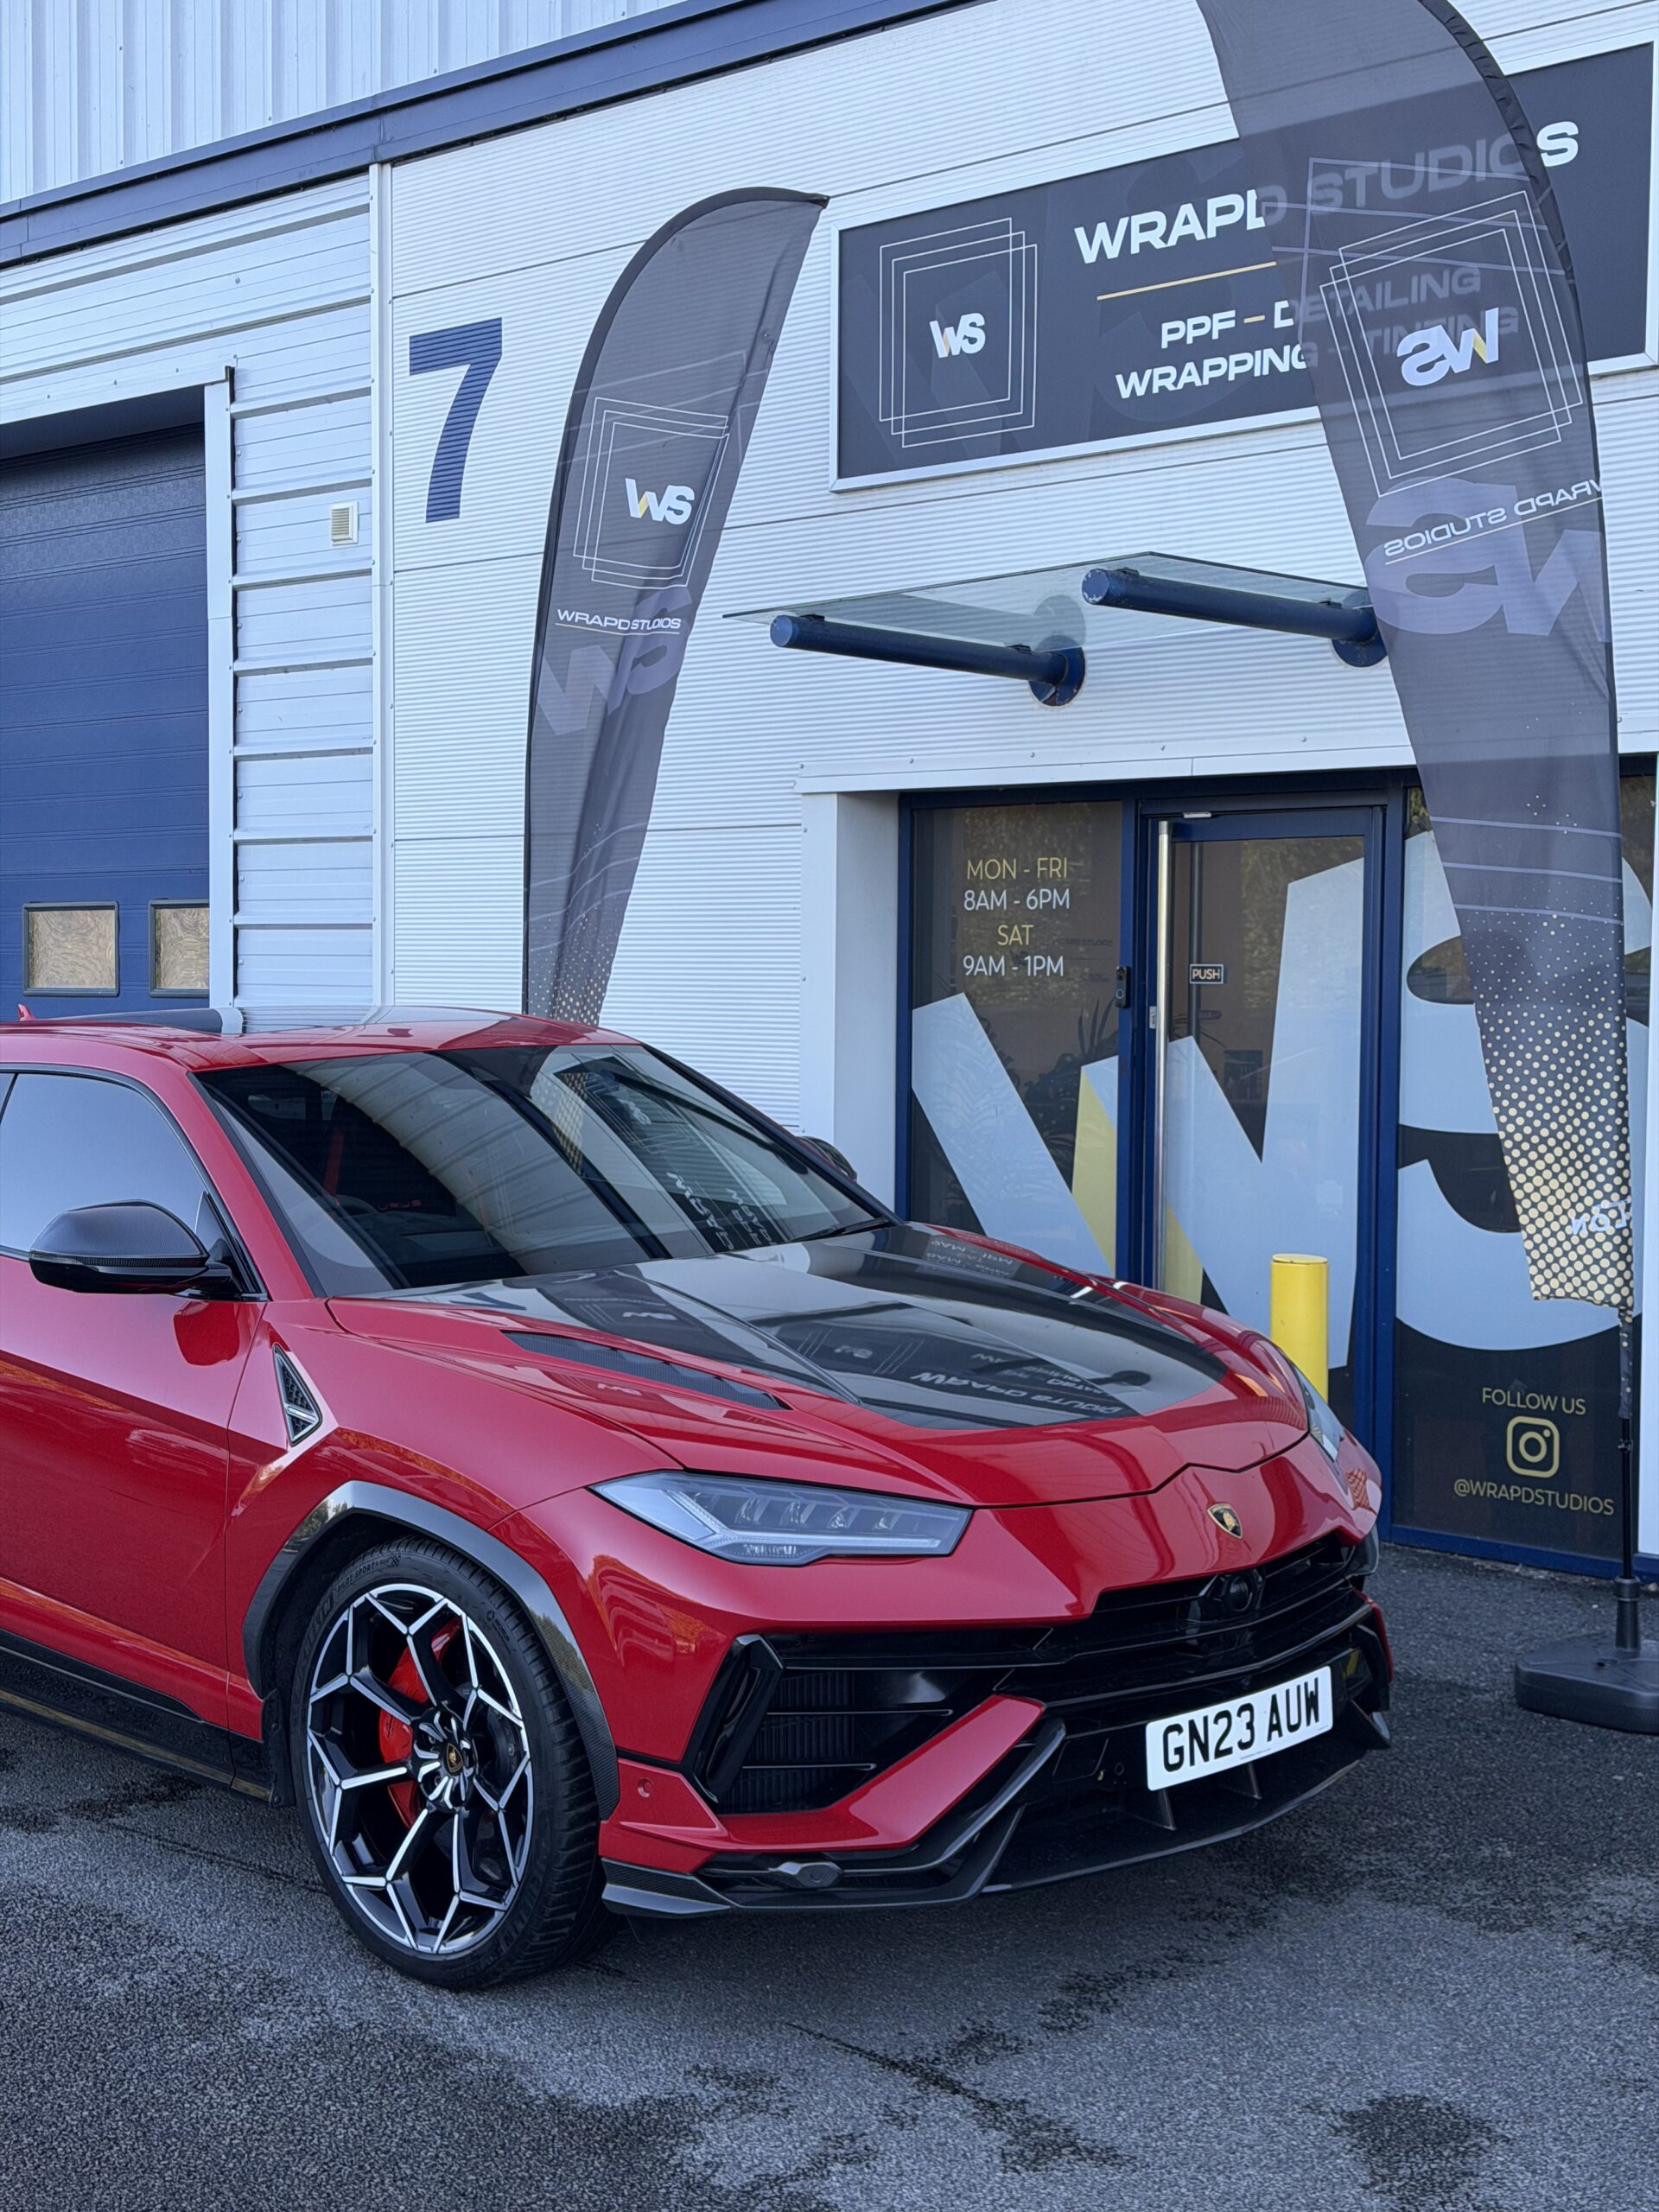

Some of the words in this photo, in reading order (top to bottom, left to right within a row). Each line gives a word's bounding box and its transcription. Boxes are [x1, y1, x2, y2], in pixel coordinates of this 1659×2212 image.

[929, 311, 986, 359] WS
[1160, 309, 1236, 349] PPF
[1115, 340, 1319, 399] WRAPPING
[409, 316, 503, 524] 7
[624, 477, 696, 525] WS
[556, 608, 631, 631] WRAPD
[630, 617, 682, 631] STUDIOS
[966, 858, 1017, 880] MON
[1036, 856, 1068, 879] FRI
[963, 888, 1007, 911] 8AM
[1026, 888, 1071, 910] 6PM
[996, 924, 1034, 946] SAT
[963, 954, 1006, 977] 9AM
[1024, 955, 1065, 977] 1PM
[1192, 968, 1221, 980] PUSH
[1482, 1387, 1558, 1411] FOLLOW
[1561, 1395, 1586, 1415] US
[1453, 1478, 1615, 1516] @WRAPDSTUDIOS
[1162, 1701, 1255, 1773] GN23
[1266, 1676, 1320, 1744] AUW
